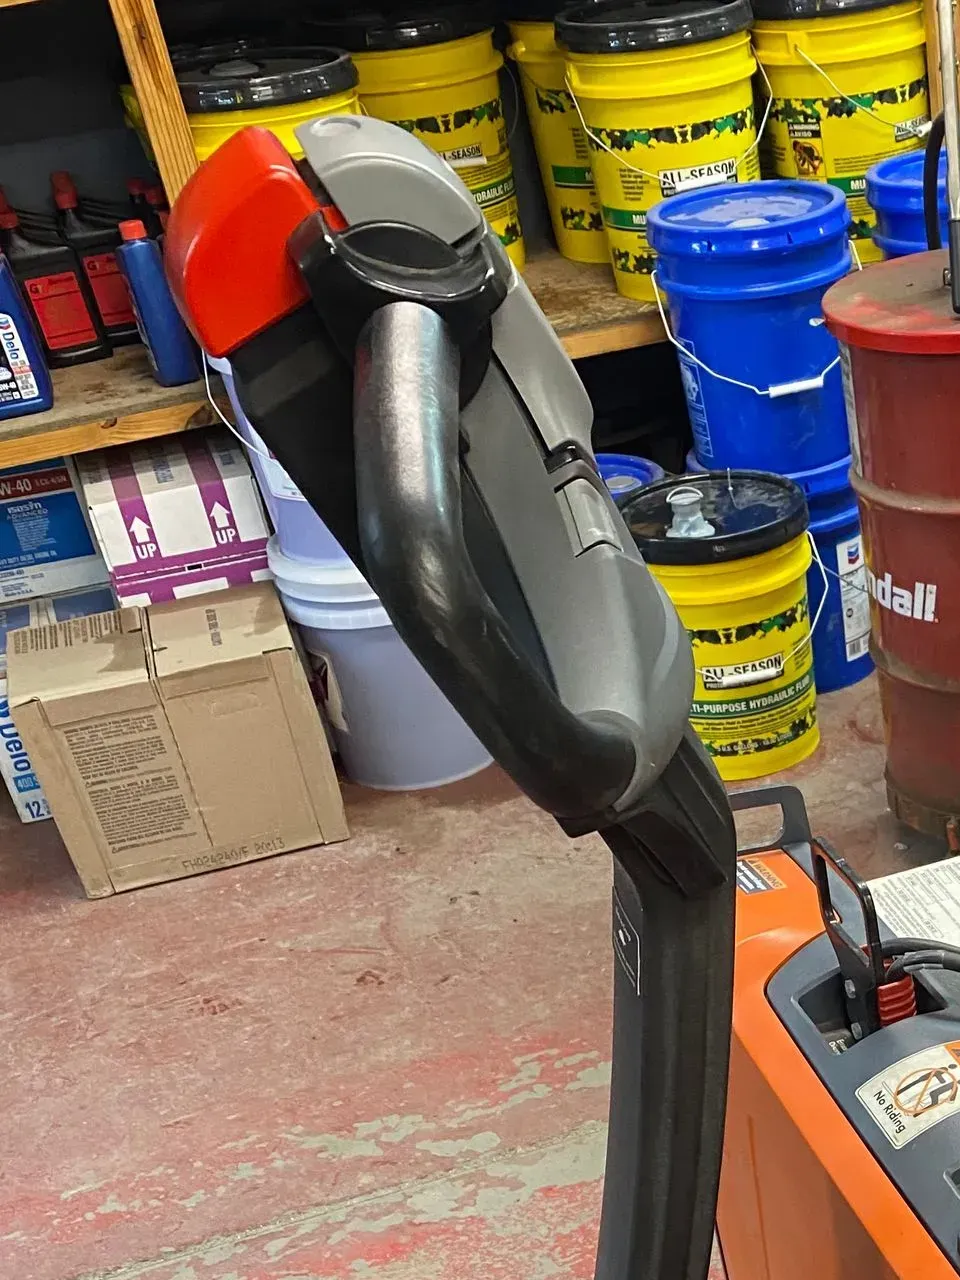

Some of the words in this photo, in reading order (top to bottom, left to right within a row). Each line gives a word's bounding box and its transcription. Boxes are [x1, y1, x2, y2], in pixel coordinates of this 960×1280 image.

[443, 144, 481, 160] L-SEASON
[2, 332, 20, 360] Delo
[0, 478, 33, 496] W-40
[215, 528, 237, 545] UP
[135, 543, 158, 560] UP
[866, 571, 937, 623] ndall
[690, 702, 748, 714] TI-PURPOSE
[749, 686, 795, 710] HYDRAULIC
[795, 674, 810, 692] FLUID
[25, 800, 45, 819] 12
[873, 1089, 886, 1107] No
[882, 1103, 907, 1135] Riding
